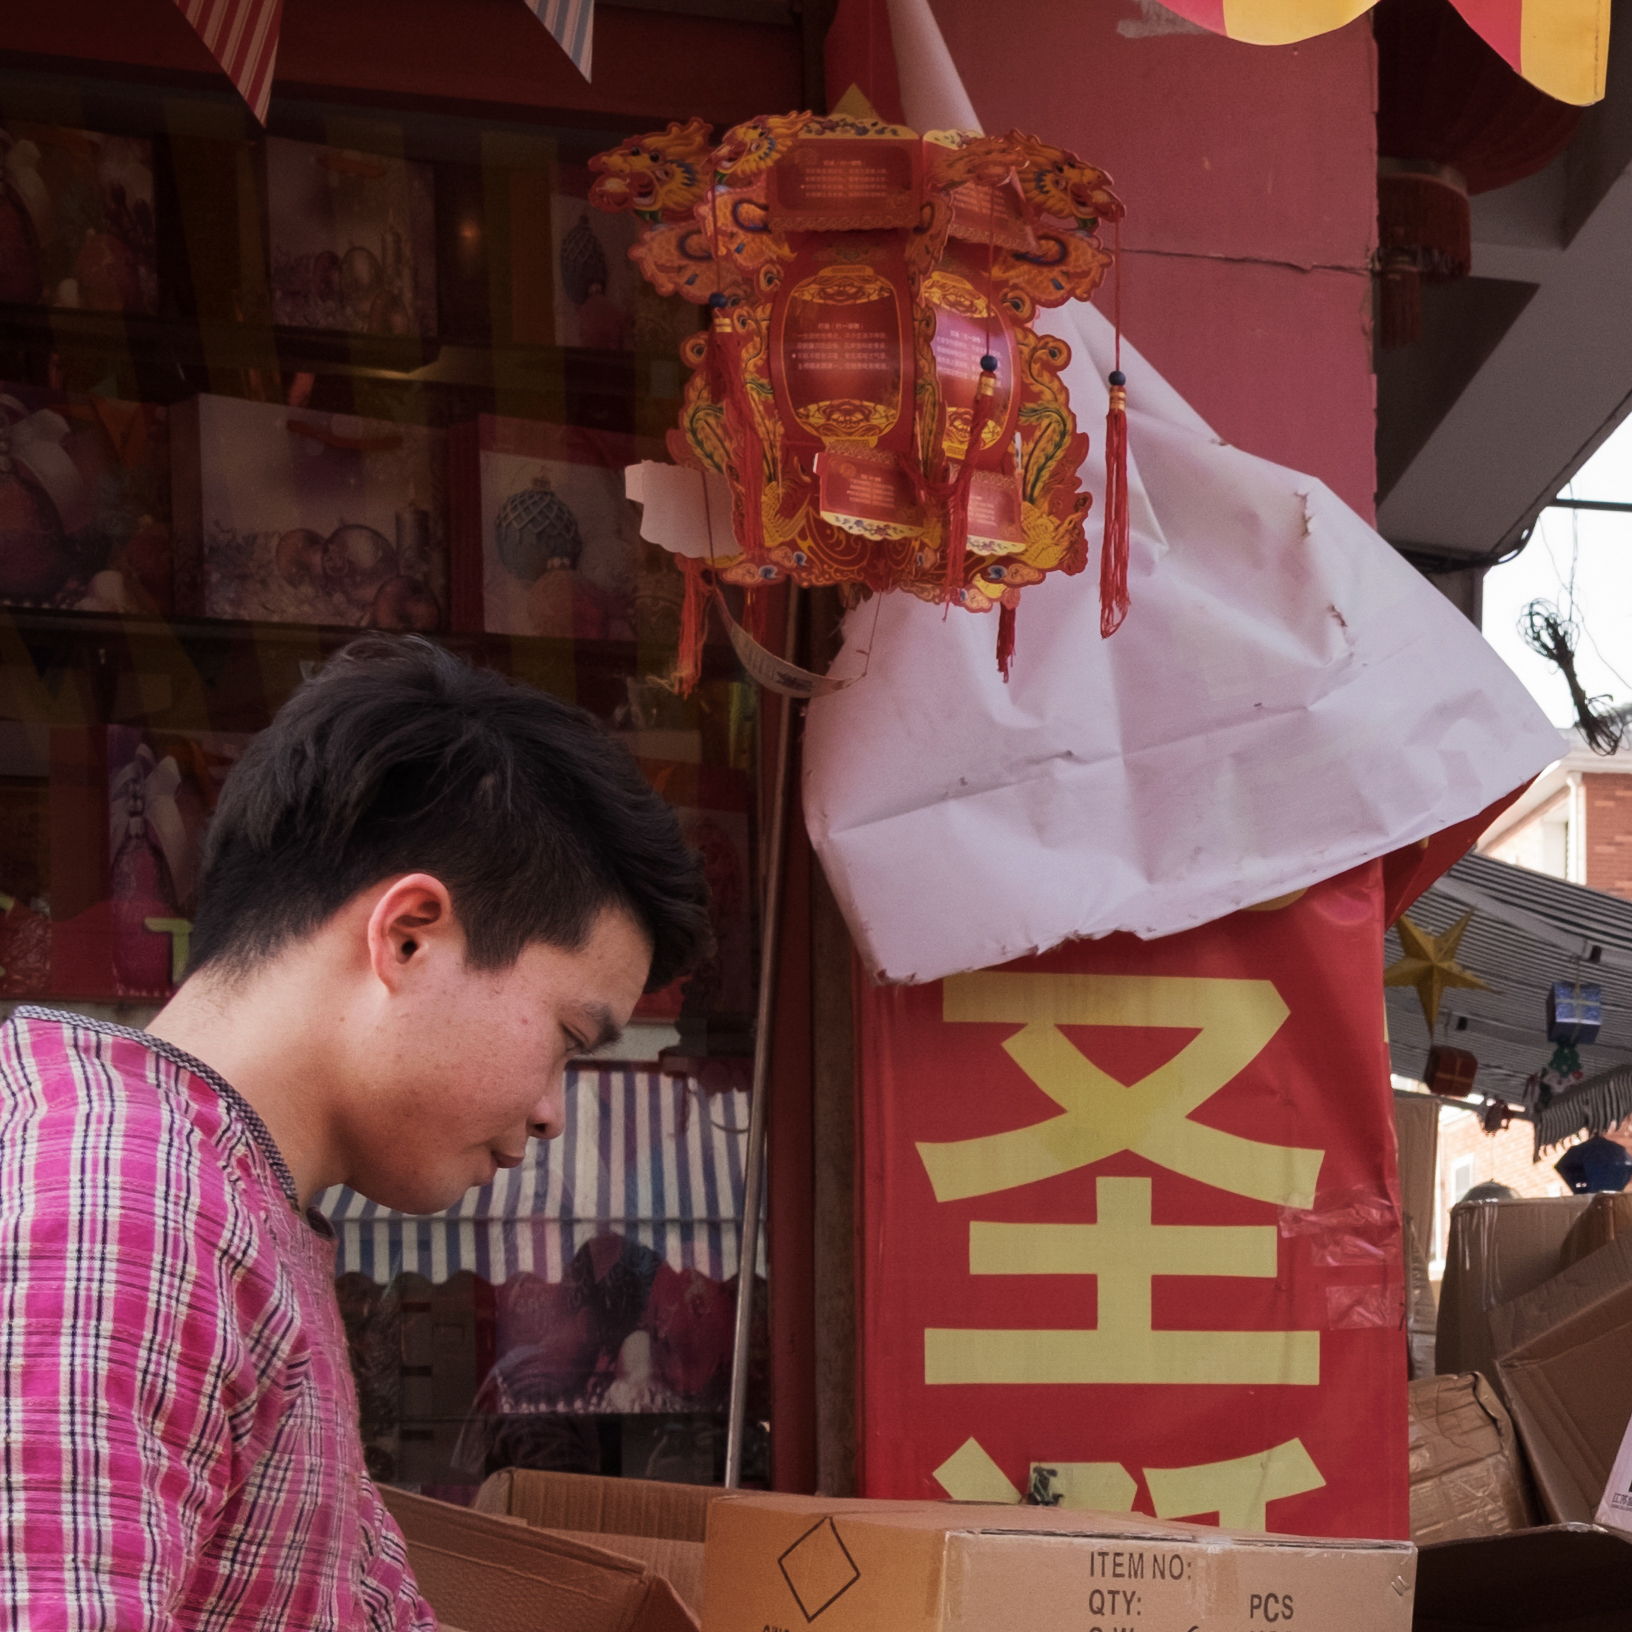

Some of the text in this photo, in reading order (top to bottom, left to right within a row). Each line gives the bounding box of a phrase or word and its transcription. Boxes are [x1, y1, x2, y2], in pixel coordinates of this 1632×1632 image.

[915, 971, 1327, 1533] 圣
[1090, 1551, 1192, 1581] ITEM NO:
[1088, 1589, 1295, 1623] QTY: PCS
